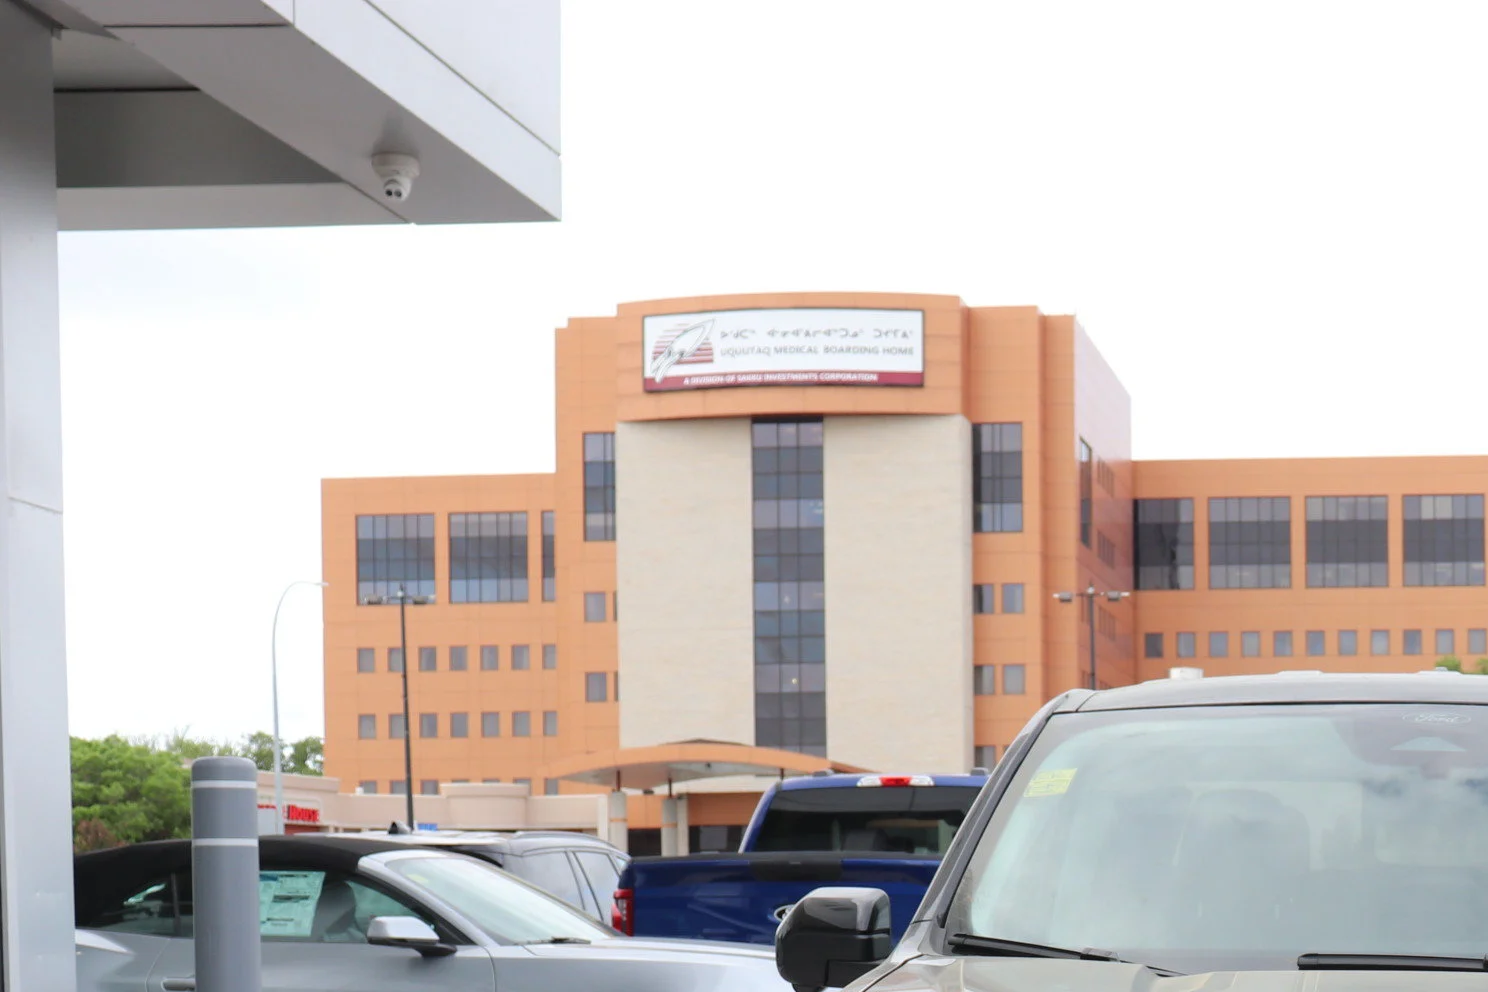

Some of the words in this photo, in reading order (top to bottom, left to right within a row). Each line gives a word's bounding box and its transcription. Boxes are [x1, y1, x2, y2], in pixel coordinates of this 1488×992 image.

[773, 344, 819, 355] MEDICAL
[823, 344, 879, 355] BOARDING
[882, 345, 914, 356] HOME
